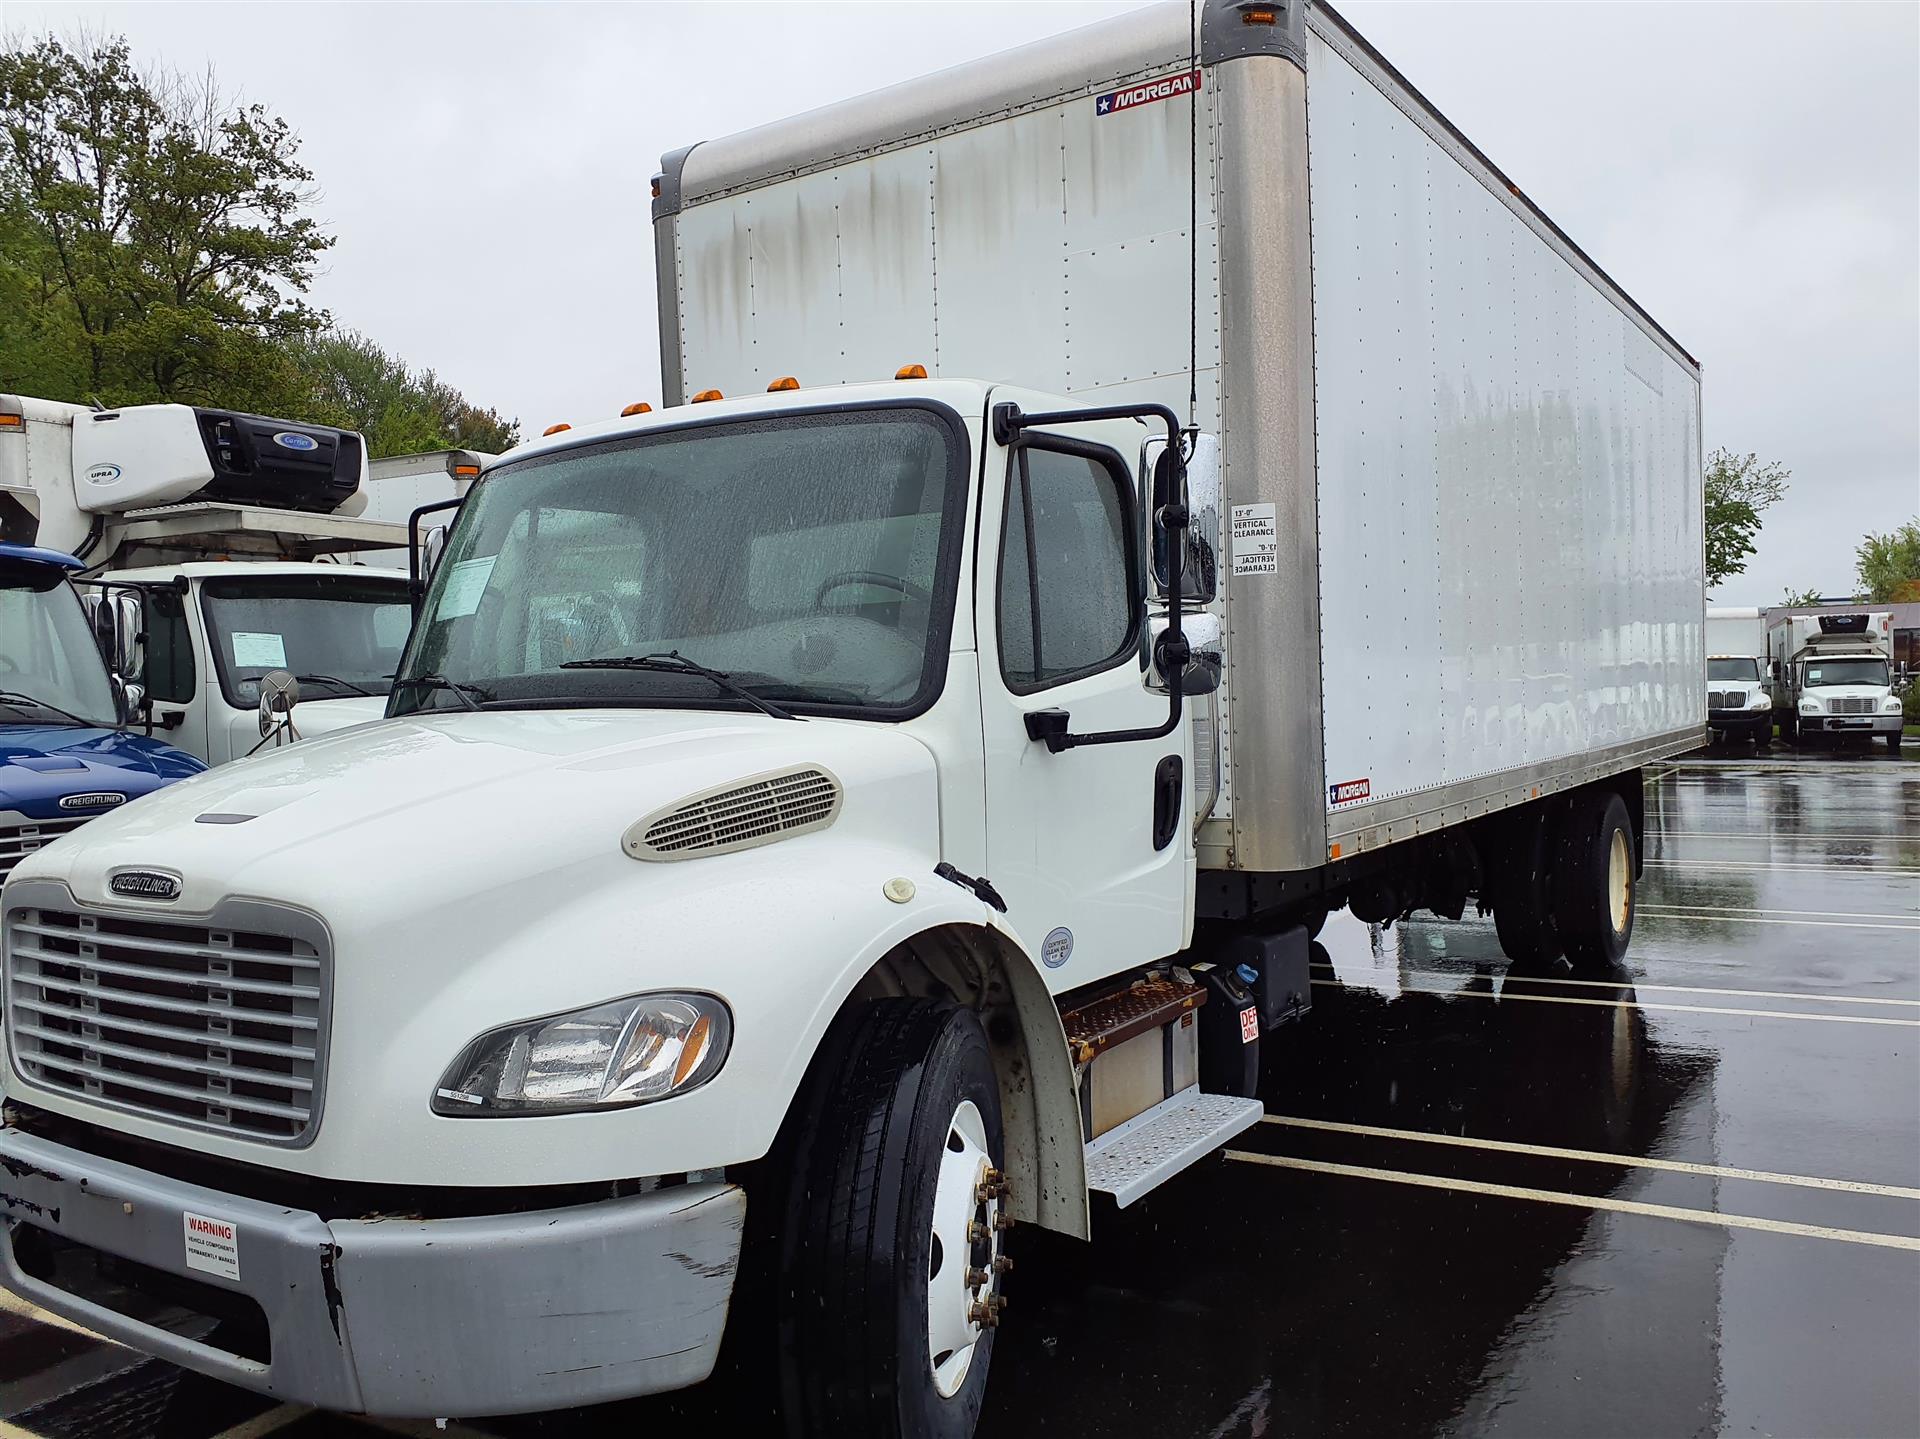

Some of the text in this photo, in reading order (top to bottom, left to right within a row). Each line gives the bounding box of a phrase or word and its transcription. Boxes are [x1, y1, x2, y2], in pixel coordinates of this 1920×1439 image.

[1115, 75, 1198, 108] MORGAN
[284, 436, 310, 446] Carrier
[91, 470, 112, 478] UPRA
[1234, 520, 1267, 529] VERTICAL
[1234, 528, 1274, 538] CLEARANCE
[1337, 782, 1369, 800] MORGAN
[68, 795, 121, 806] FREIGHTLINER
[112, 876, 172, 893] FREIGHTLINER
[1241, 1008, 1257, 1027] DEF
[1243, 1024, 1258, 1039] ONLY
[189, 1217, 231, 1239] WARNING
[188, 1236, 235, 1253] VEHICLE COMPONENTS
[188, 1247, 236, 1265] PERMANENTLY MARKED
